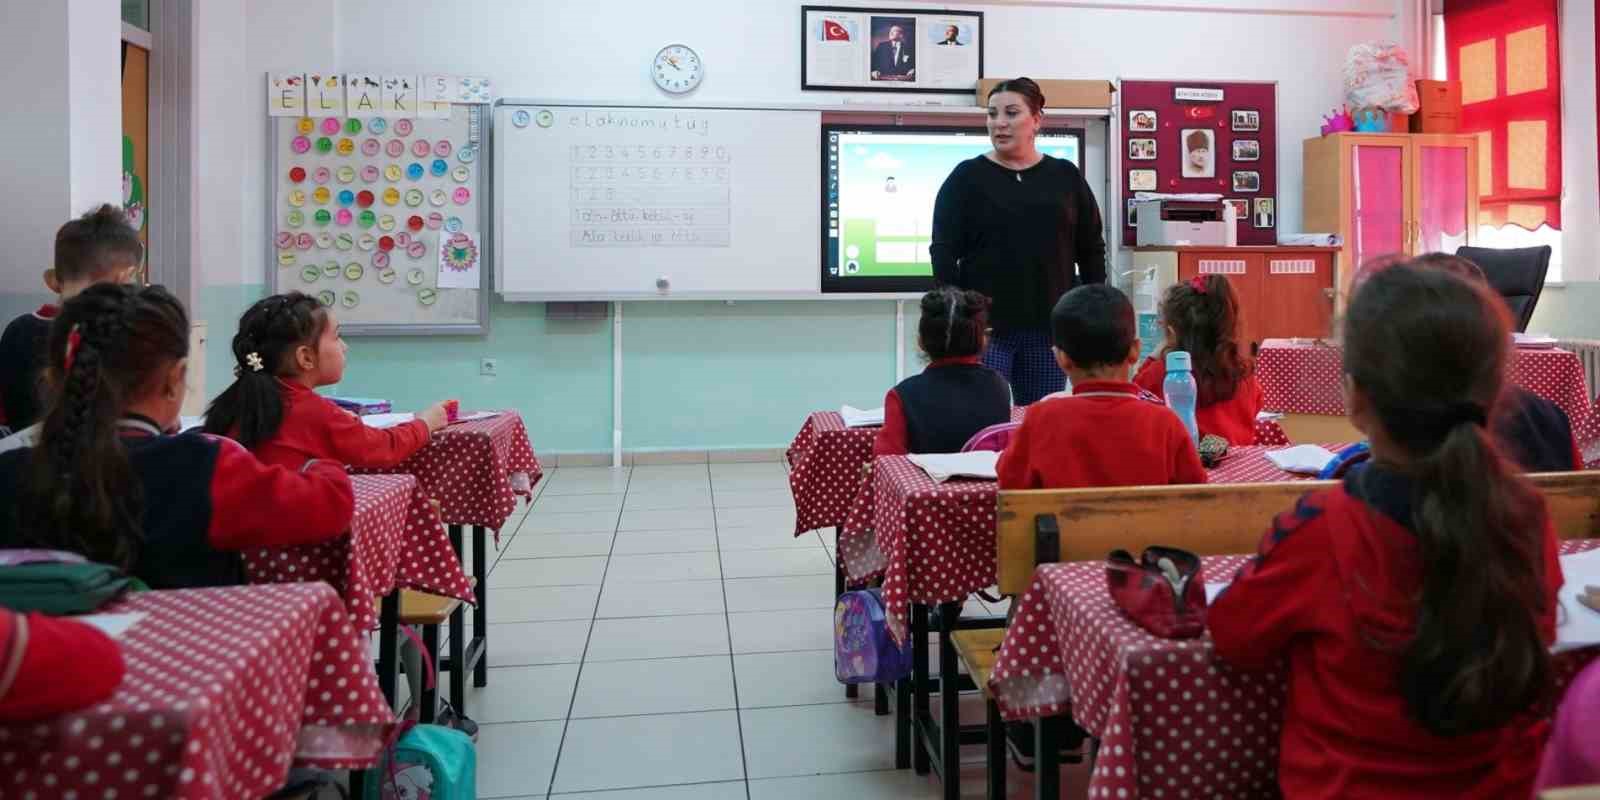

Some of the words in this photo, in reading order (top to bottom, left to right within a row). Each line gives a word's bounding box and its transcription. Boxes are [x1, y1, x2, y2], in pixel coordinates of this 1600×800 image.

[436, 77, 447, 93] 5
[281, 89, 294, 109] E
[320, 90, 332, 110] L
[357, 92, 373, 110] A
[394, 93, 406, 111] K
